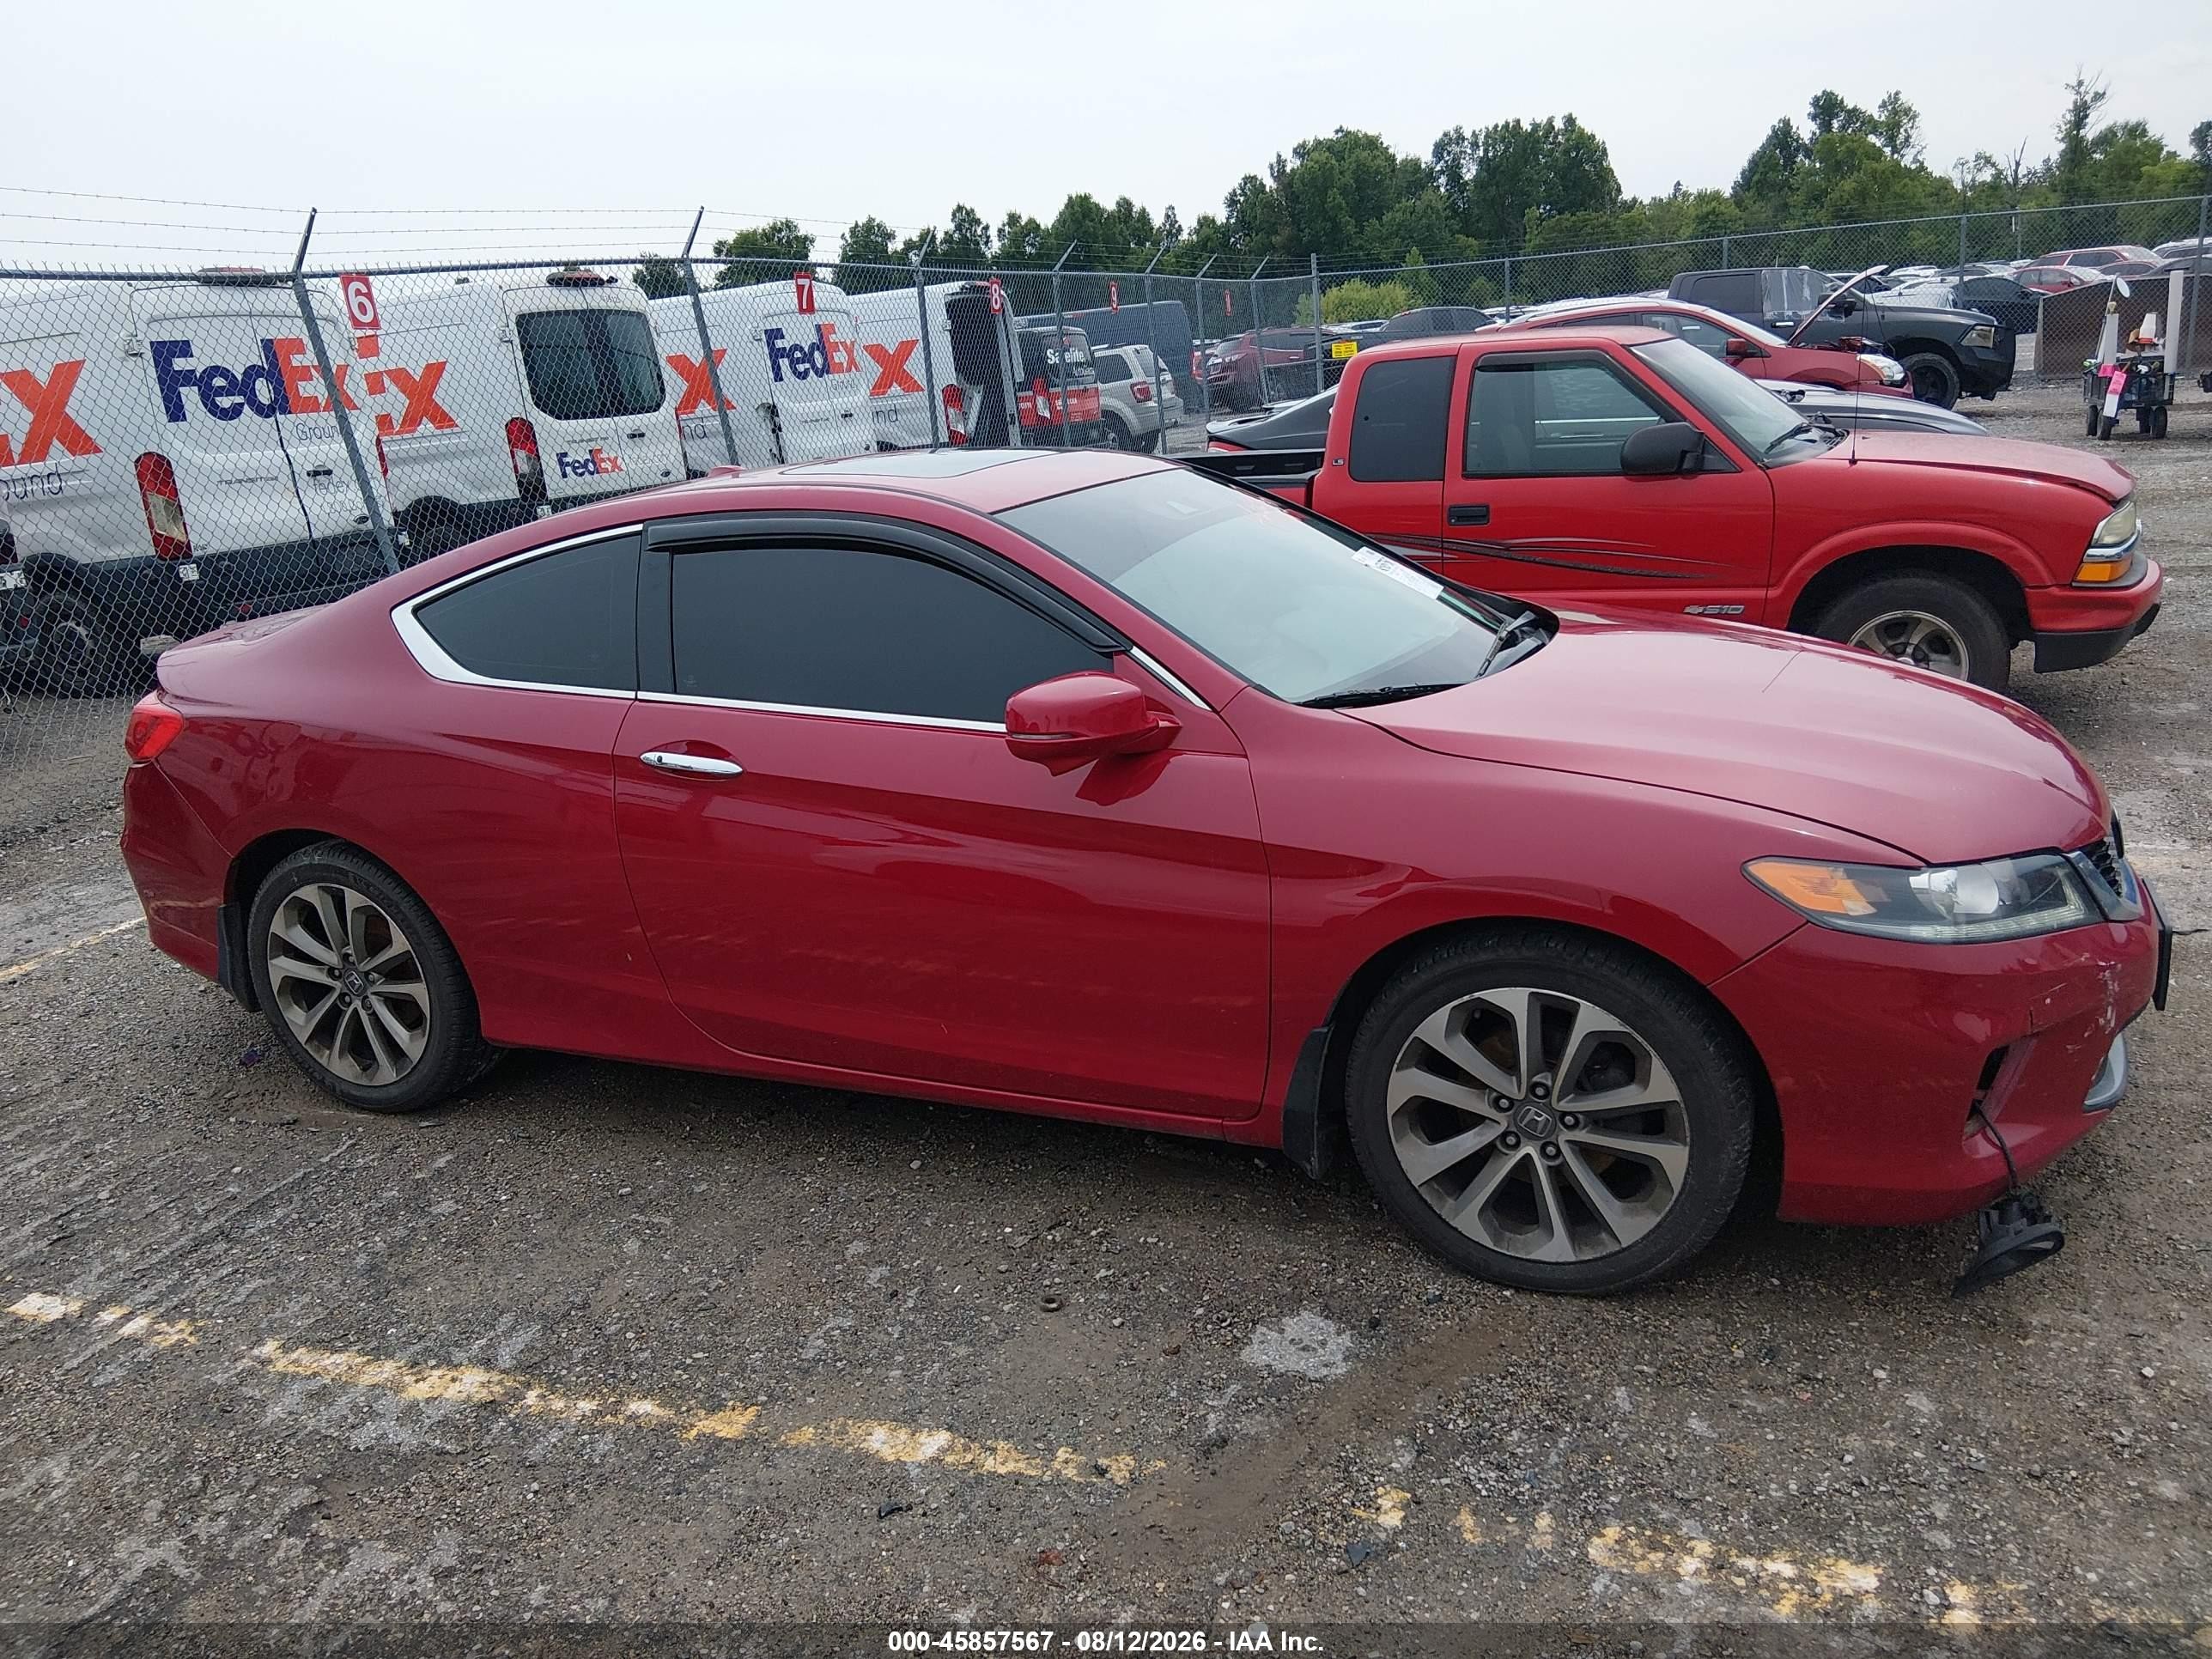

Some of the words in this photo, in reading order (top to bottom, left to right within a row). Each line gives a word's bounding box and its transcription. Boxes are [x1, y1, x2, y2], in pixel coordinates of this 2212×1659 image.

[347, 281, 374, 323] 6
[798, 279, 810, 308] 7
[991, 284, 1000, 310] 8
[1111, 287, 1117, 307] 9
[764, 323, 862, 383] FedEx
[149, 338, 362, 423] FedEx
[295, 422, 342, 441] Groun
[556, 447, 625, 478] FedEx
[1703, 605, 1745, 615] S10
